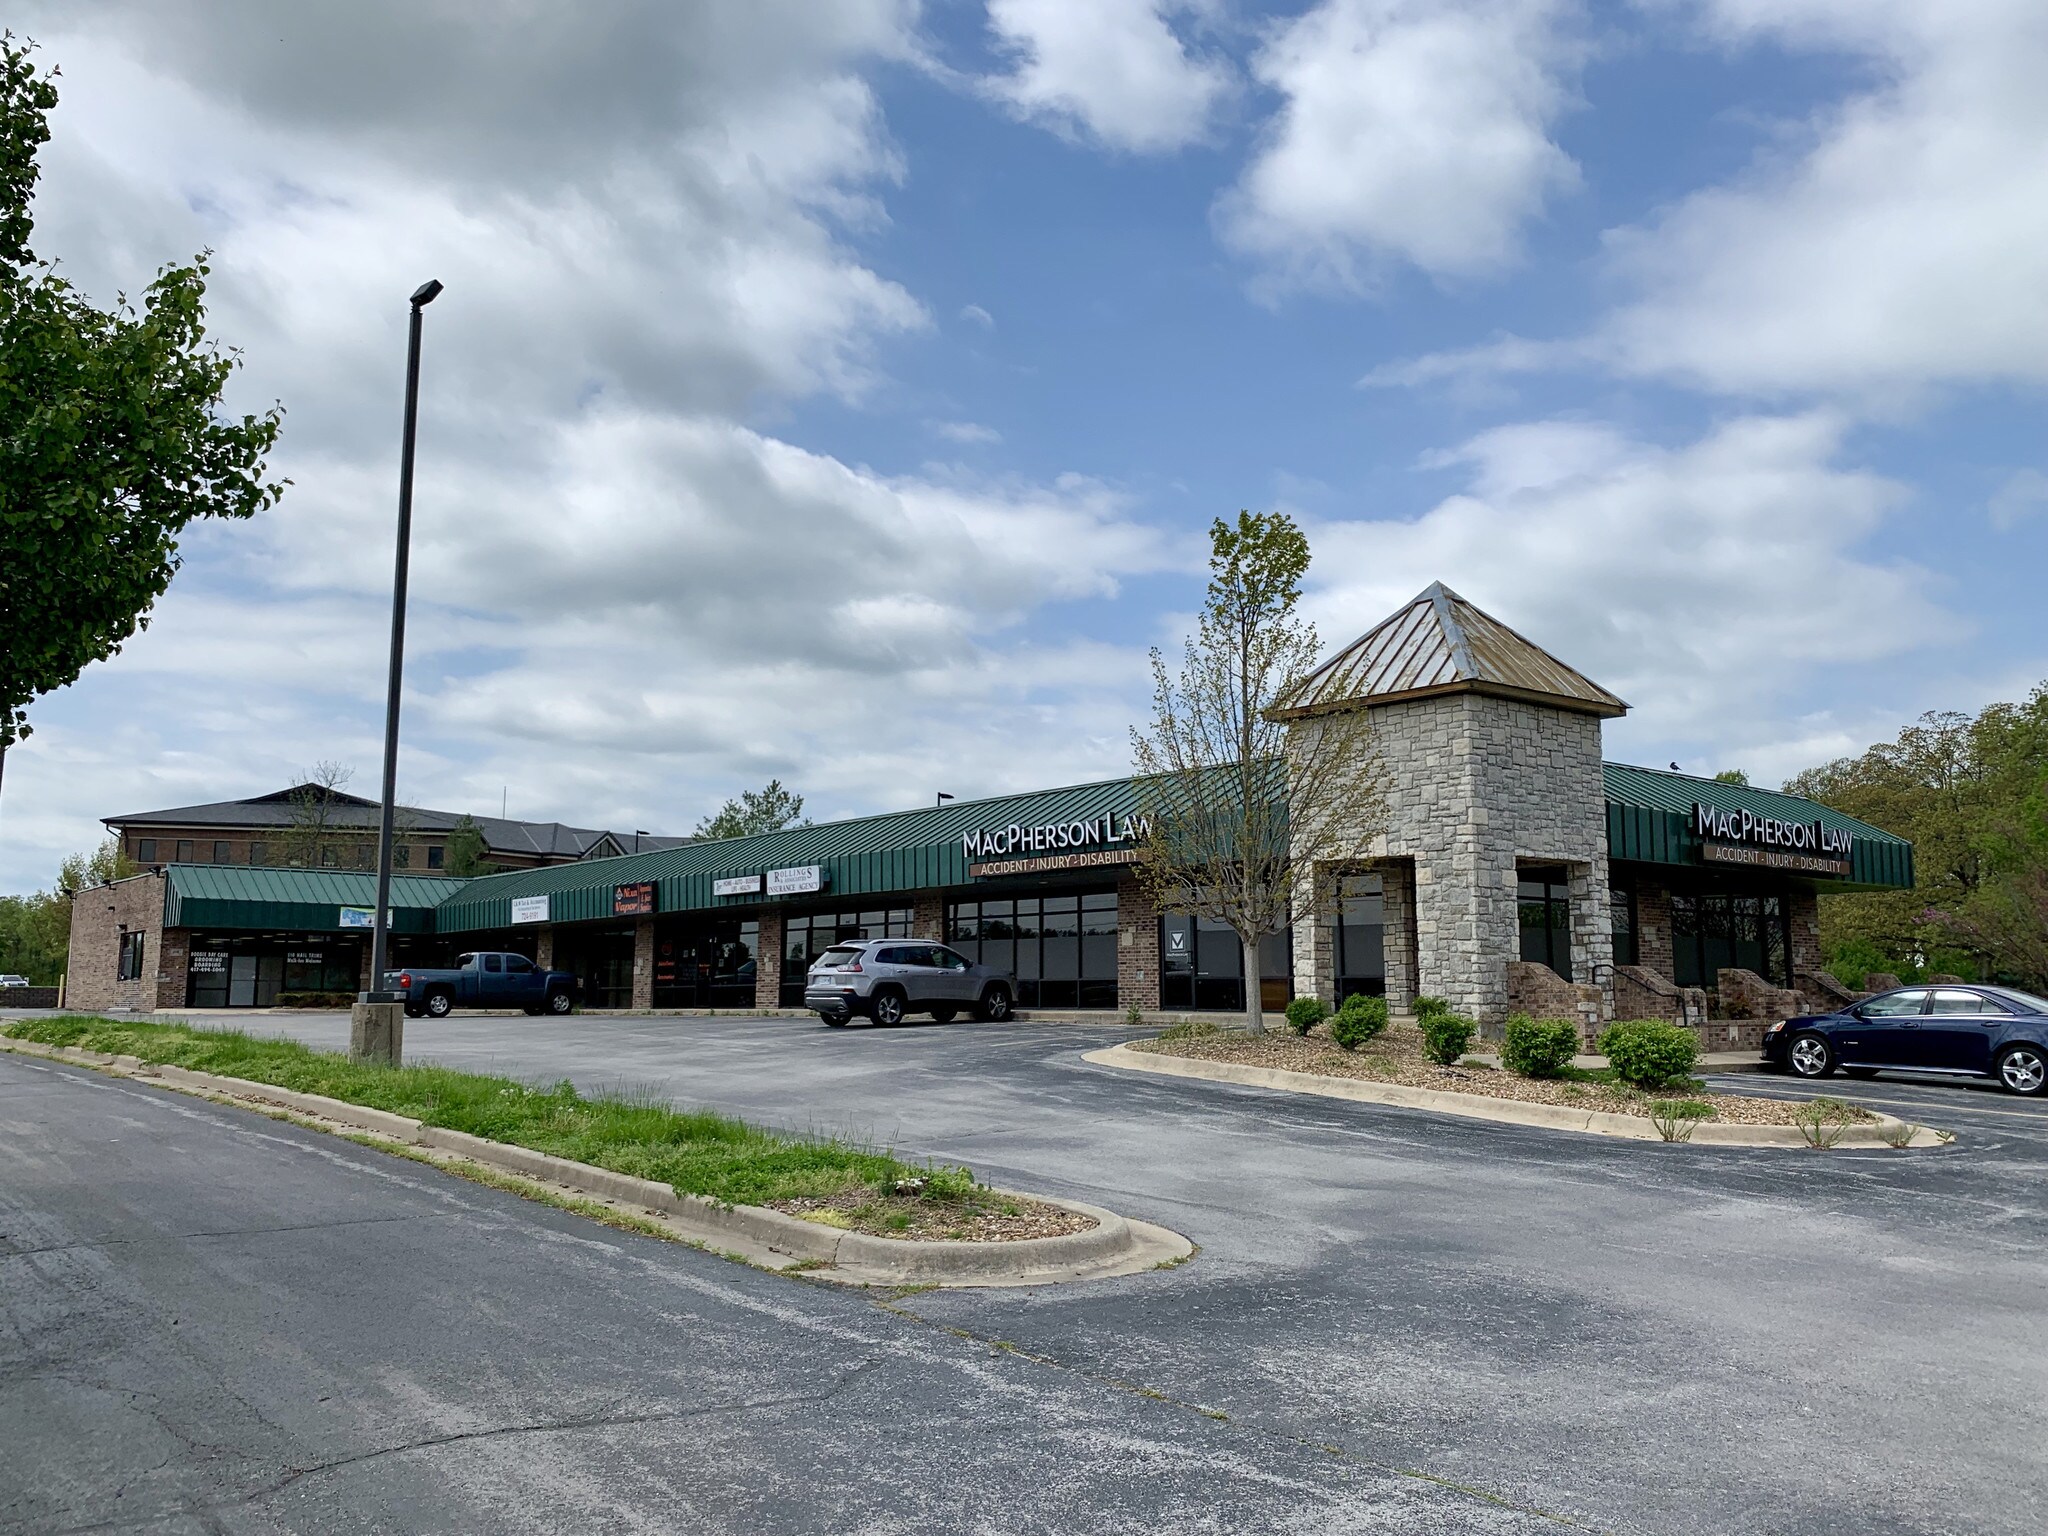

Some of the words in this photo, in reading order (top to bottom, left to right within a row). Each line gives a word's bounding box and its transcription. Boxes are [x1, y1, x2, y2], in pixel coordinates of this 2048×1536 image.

[980, 860, 1029, 875] ACCIDENT
[1036, 856, 1071, 870] INJURY
[1080, 850, 1138, 867] DISABILITY
[1715, 848, 1759, 863] ACCIDENT
[1766, 855, 1795, 868] INJURY
[1801, 859, 1841, 873] DISABILITY
[768, 884, 796, 893] INSURANCE
[799, 882, 818, 890] AGENCY
[615, 901, 638, 913] Vapor
